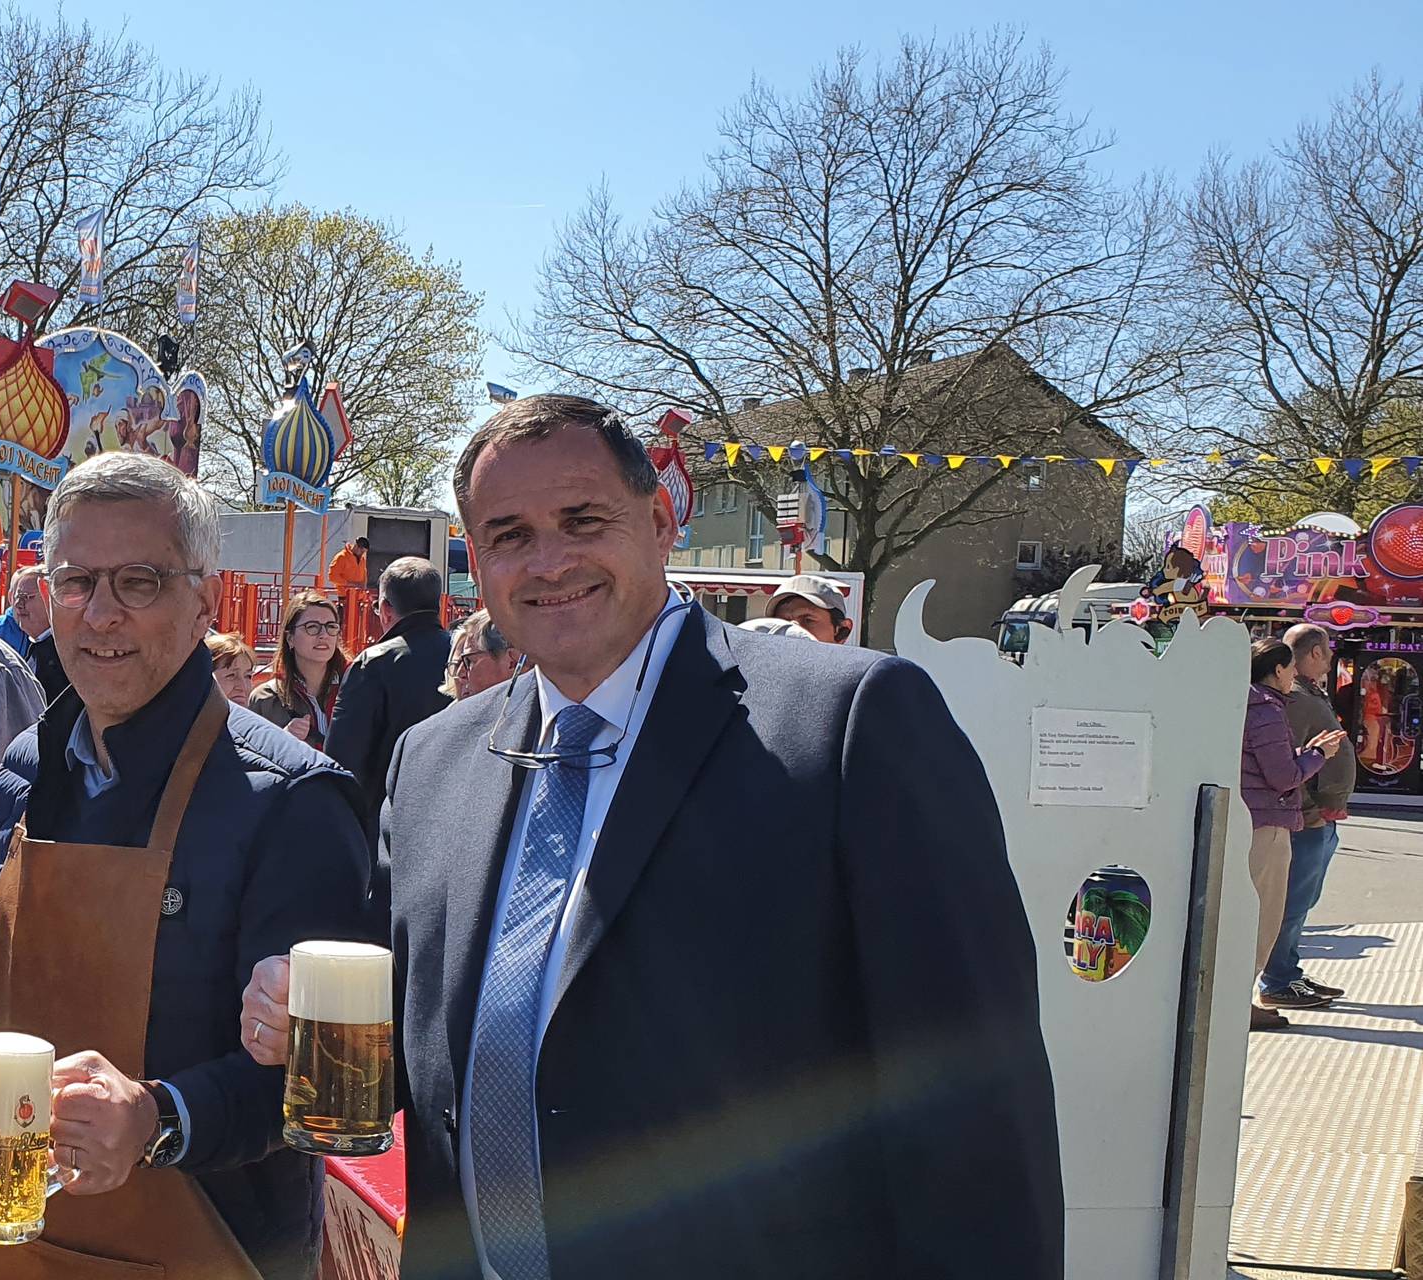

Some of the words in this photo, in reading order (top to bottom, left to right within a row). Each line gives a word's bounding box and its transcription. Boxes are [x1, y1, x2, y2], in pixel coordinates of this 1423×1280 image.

[16, 449, 62, 484] NACHT
[267, 476, 290, 494] 1001
[292, 480, 326, 508] NACHT
[1260, 536, 1370, 580] Pink
[1365, 642, 1397, 652] PINK
[1399, 642, 1423, 652] DAT
